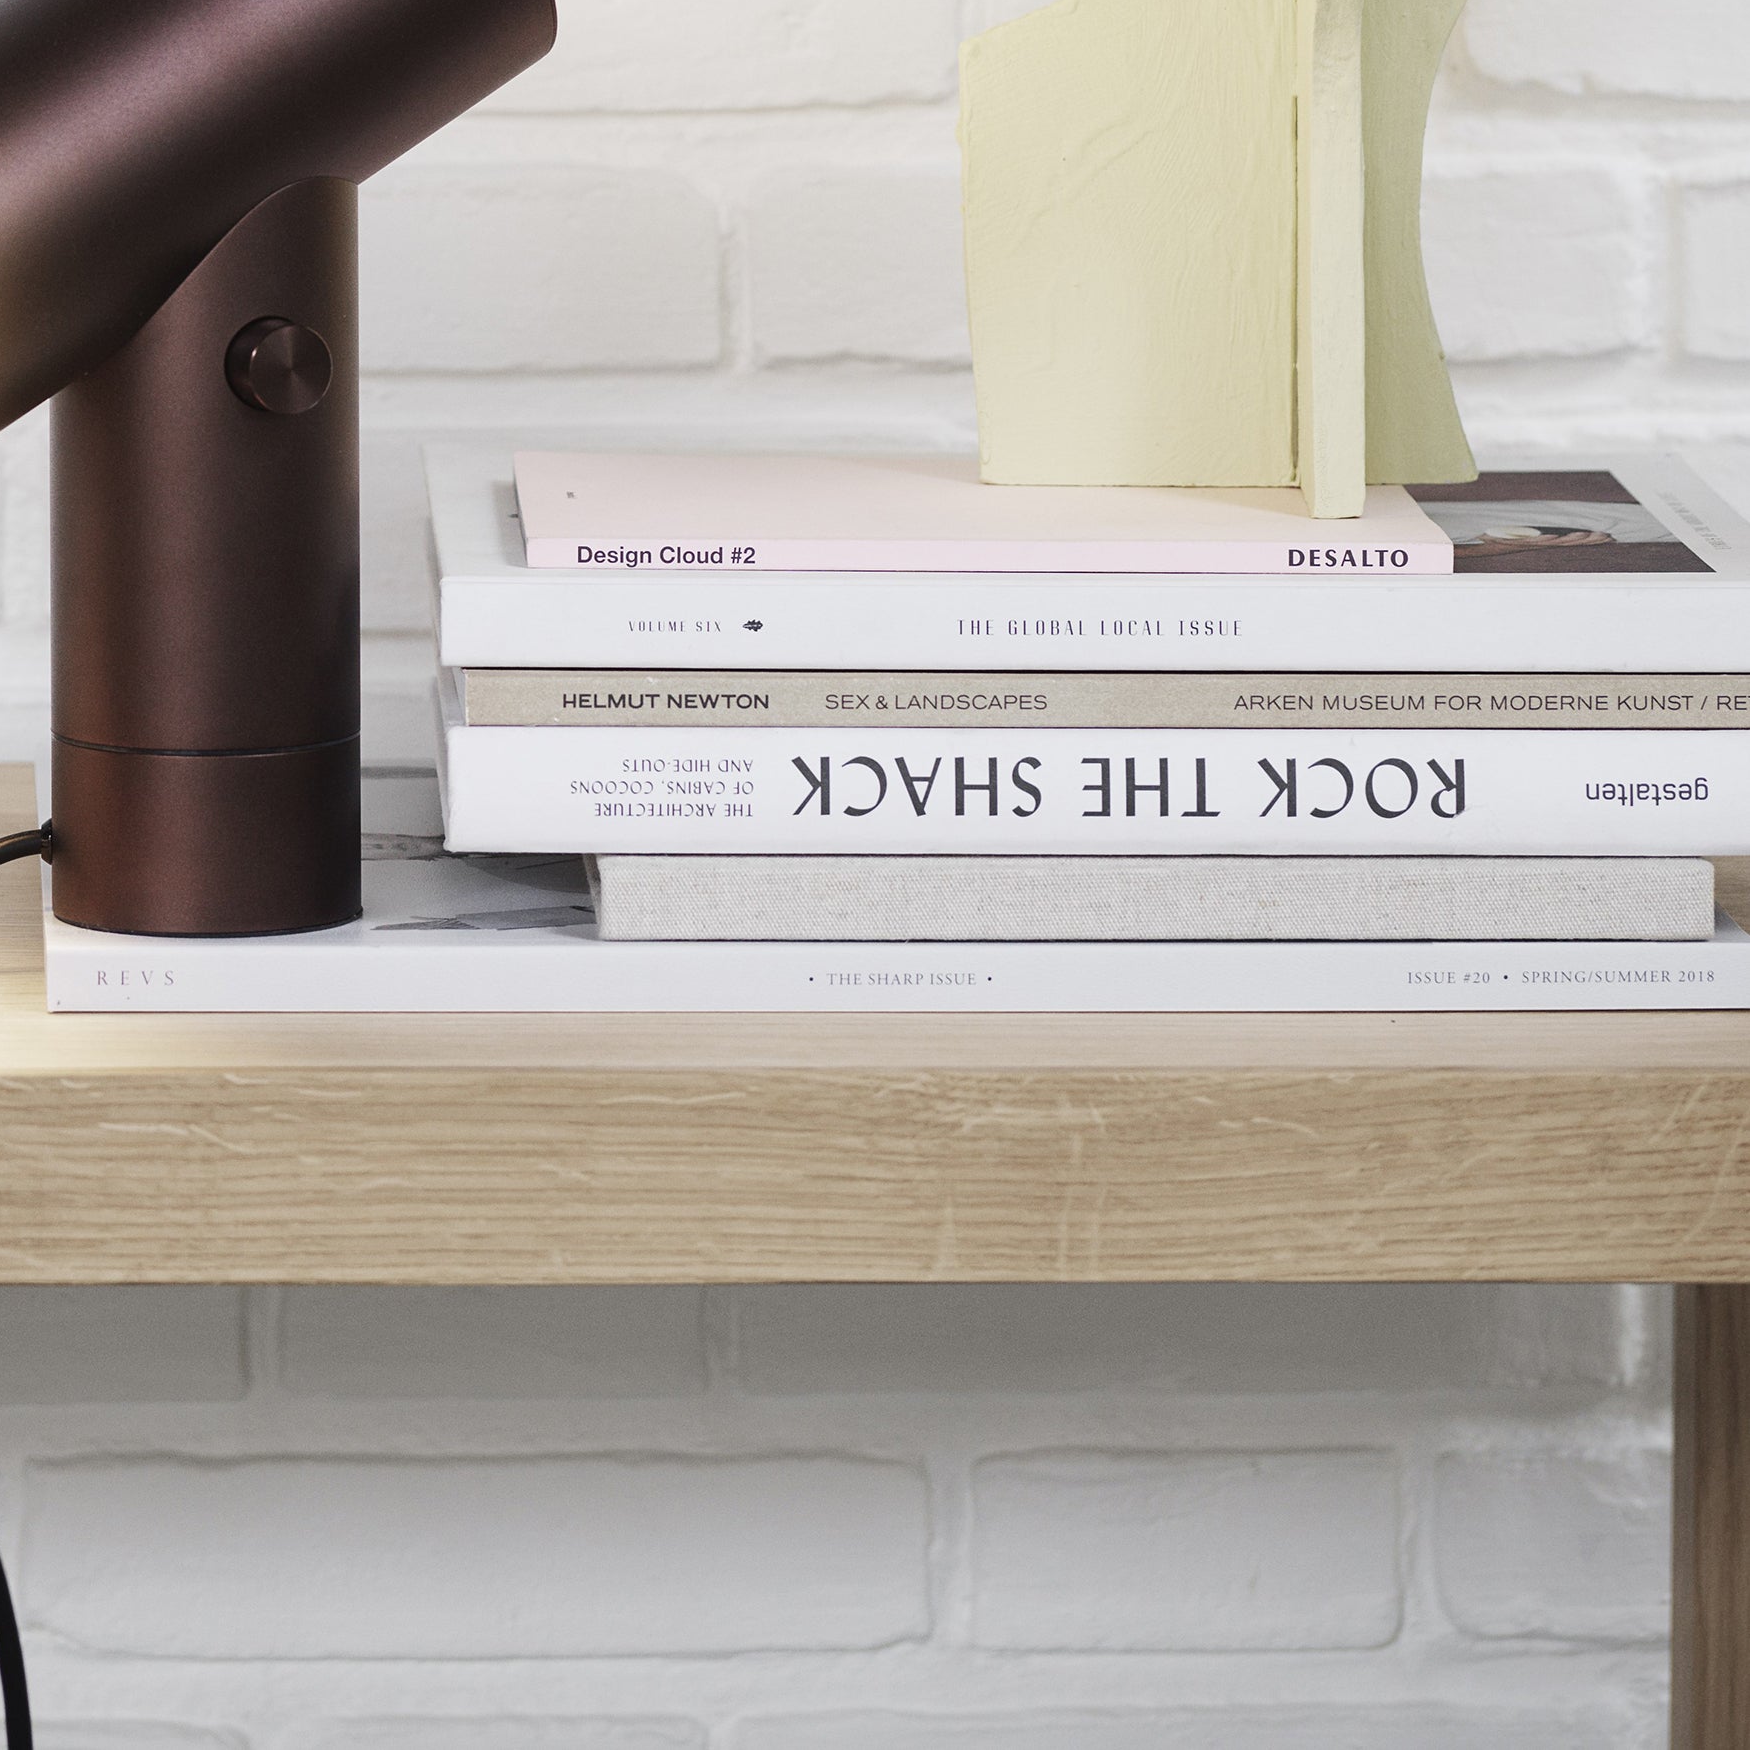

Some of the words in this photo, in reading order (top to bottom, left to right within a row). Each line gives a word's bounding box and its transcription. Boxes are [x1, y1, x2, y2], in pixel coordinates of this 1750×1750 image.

[577, 545, 652, 568] Design
[659, 545, 724, 565] Cloud
[730, 546, 756, 565] #2
[1288, 548, 1409, 568] DESALTO
[628, 620, 686, 633] VOLUME
[695, 620, 721, 633] SIX
[957, 619, 994, 636] THE
[1008, 619, 1086, 636] GLOBAL
[1100, 620, 1164, 636] LOCAL
[1178, 620, 1242, 636] ISSUE
[562, 693, 661, 710] HELMUT
[666, 693, 770, 710] NEWTON
[824, 693, 870, 710] SEX
[874, 694, 891, 710] &
[895, 694, 1048, 711] LANDSCAPES
[1233, 694, 1314, 711] ARKEN
[1322, 694, 1425, 711] MUSEUM
[1434, 695, 1482, 711] FOR
[1490, 695, 1609, 711] MODERNE
[1617, 694, 1695, 711] KUNST
[622, 758, 711, 773] HIDE-OUTS
[717, 758, 754, 773] AND
[570, 780, 654, 796] COCOONS
[661, 780, 726, 796] CABINS,
[733, 780, 754, 796] OF
[790, 755, 1043, 818] SHACK
[1080, 756, 1221, 818] THE
[1256, 757, 1466, 820] ROCK
[1585, 776, 1709, 807] gestalten
[594, 802, 716, 818] ARCHITECTURE
[724, 803, 754, 818] THE
[97, 970, 175, 986] REVS
[826, 972, 863, 986] THE
[867, 972, 924, 986] SHARP
[929, 972, 977, 986] ISSUE
[1407, 971, 1456, 985] ISSUE
[1463, 970, 1491, 985] #20
[1521, 969, 1672, 985] SPRING/SUMMER
[1677, 969, 1716, 984] 2018
